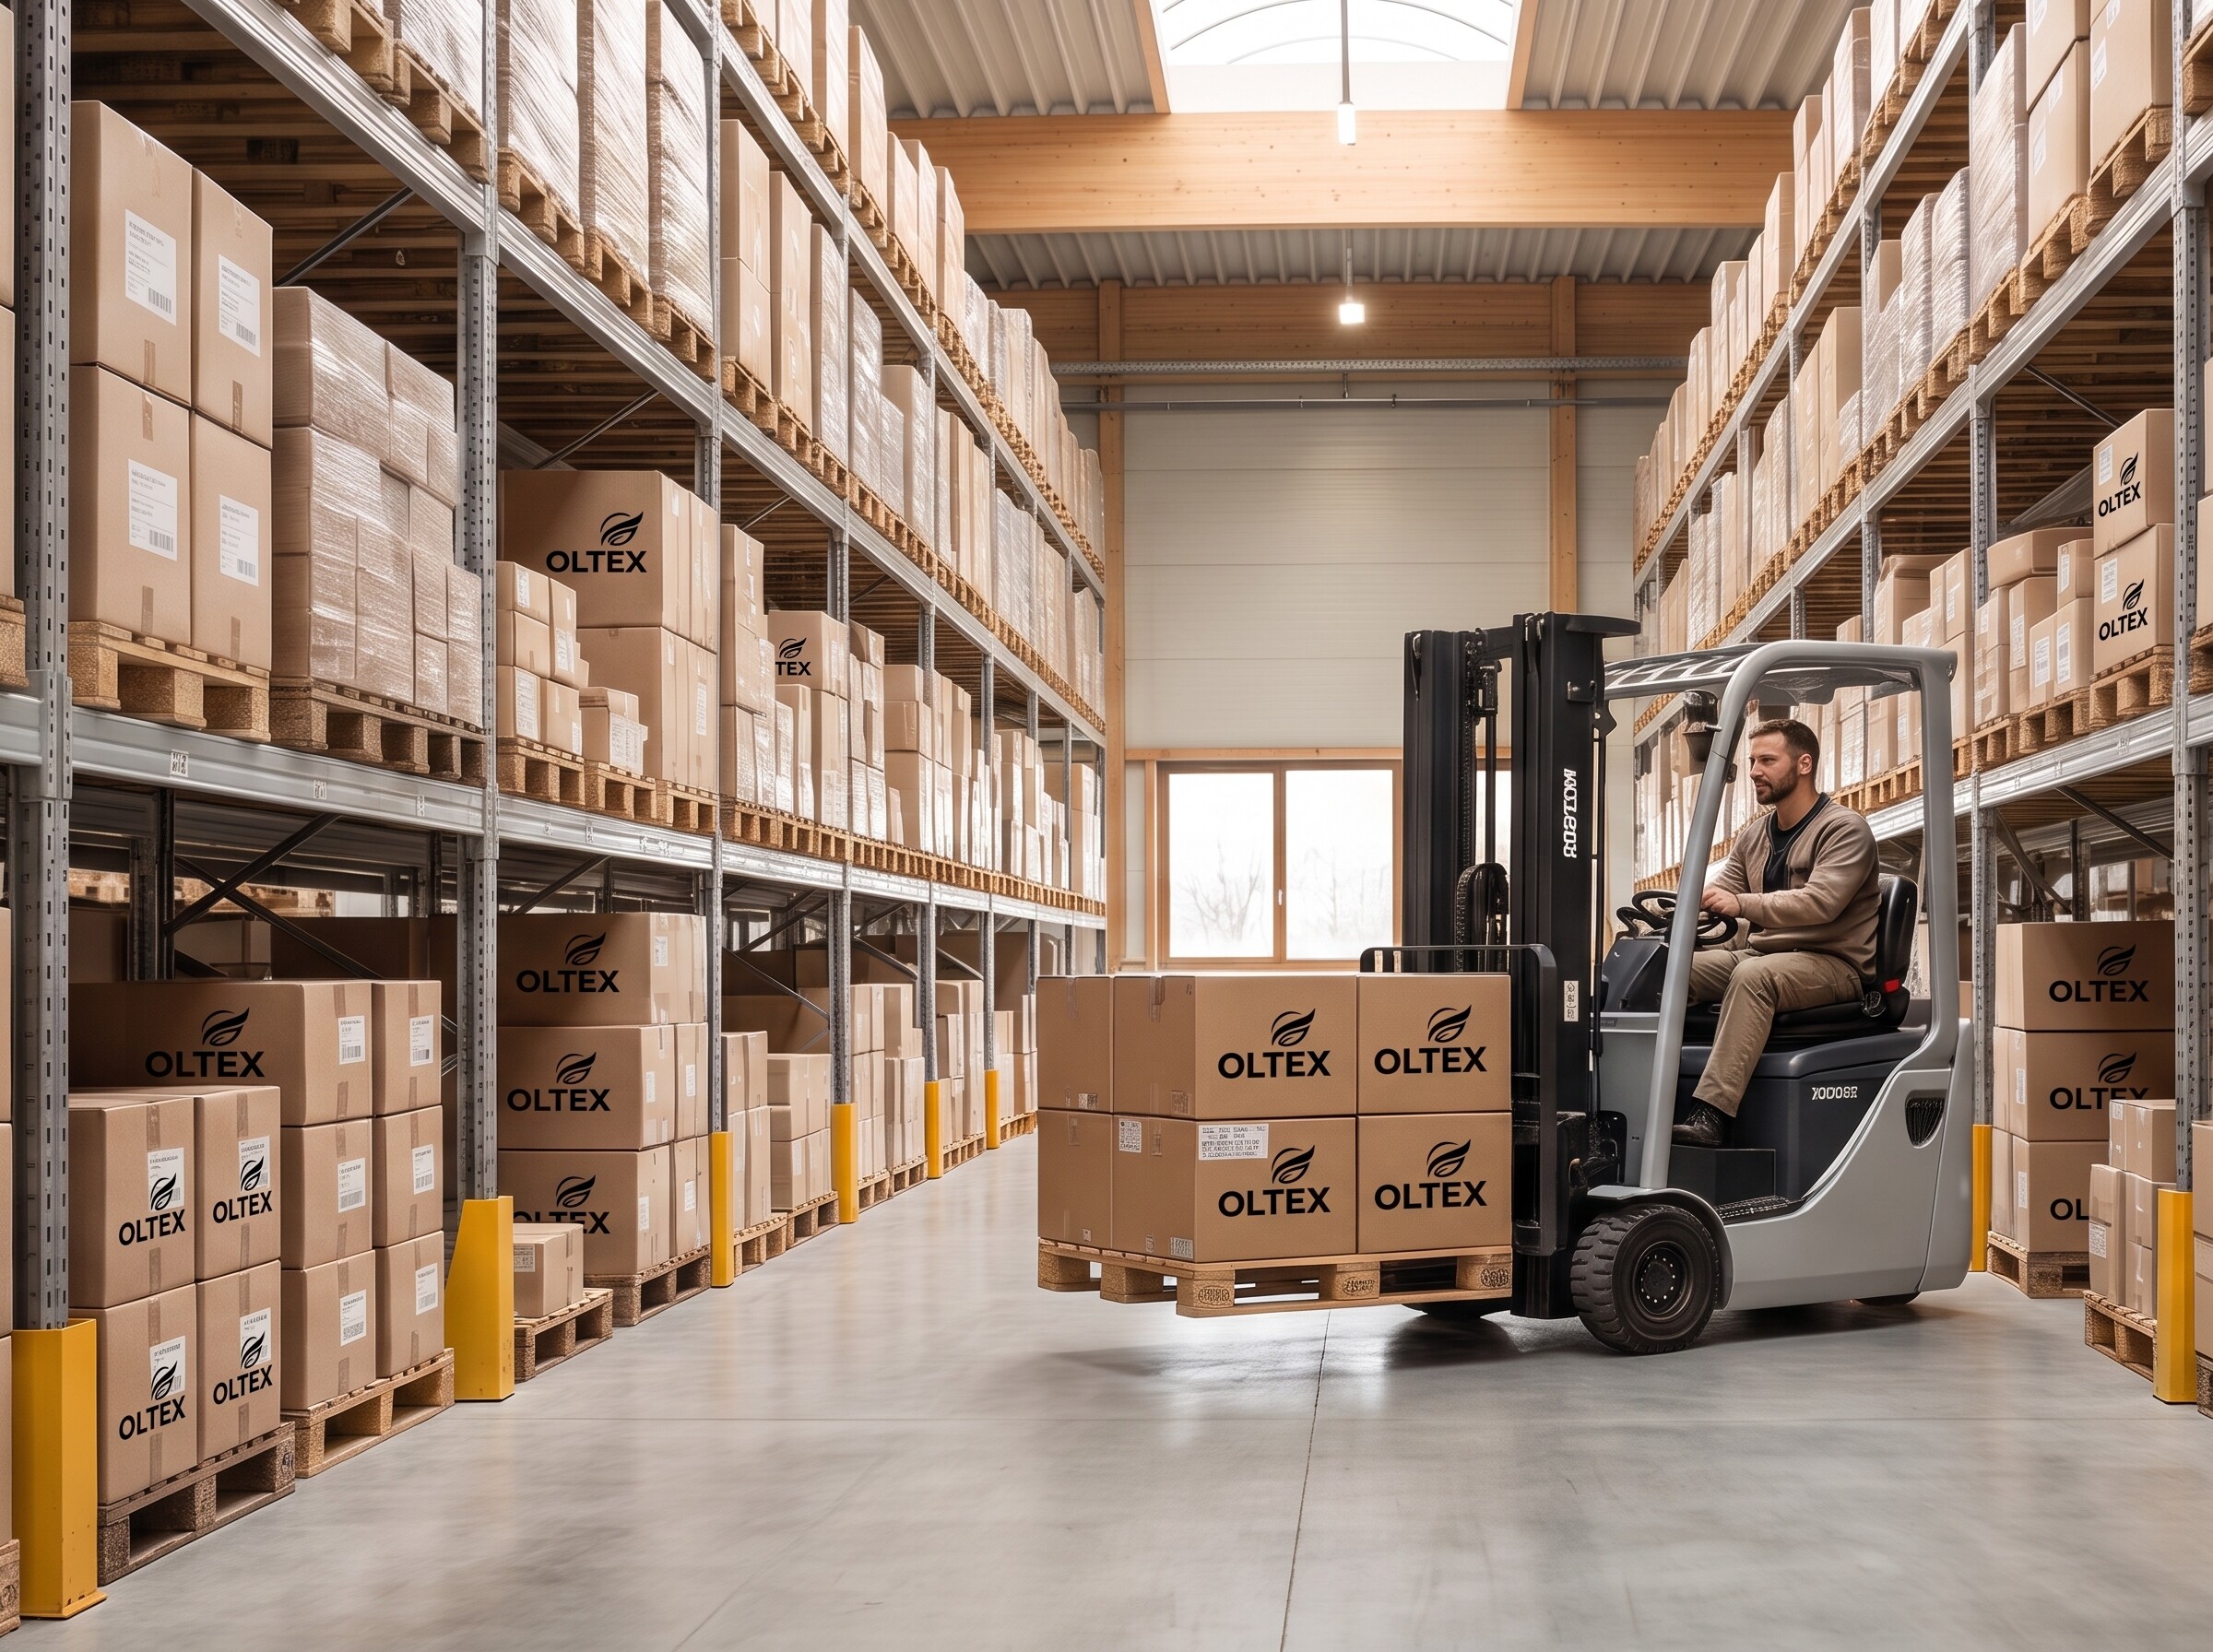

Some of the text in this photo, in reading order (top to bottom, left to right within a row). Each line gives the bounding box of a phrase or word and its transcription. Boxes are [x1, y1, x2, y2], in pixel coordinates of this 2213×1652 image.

[2098, 481, 2141, 517] OLTEX
[545, 550, 647, 573] OLTEX
[2099, 607, 2148, 641] OLTEX
[775, 661, 811, 676] TEX
[516, 970, 620, 993] OLTEX
[2049, 980, 2149, 1003] OLTEX
[145, 1051, 266, 1078] OLTEX
[1217, 1050, 1331, 1080] OLTEX
[1374, 1046, 1487, 1075] OLTEX
[507, 1088, 611, 1112] OLTEX
[212, 1190, 273, 1224] OLTEX
[1218, 1186, 1331, 1218] OLTEX
[1374, 1180, 1487, 1210] OLTEX
[118, 1209, 186, 1246] OLTEX
[213, 1364, 273, 1405] OLTEX
[119, 1395, 186, 1441] OLTEX
